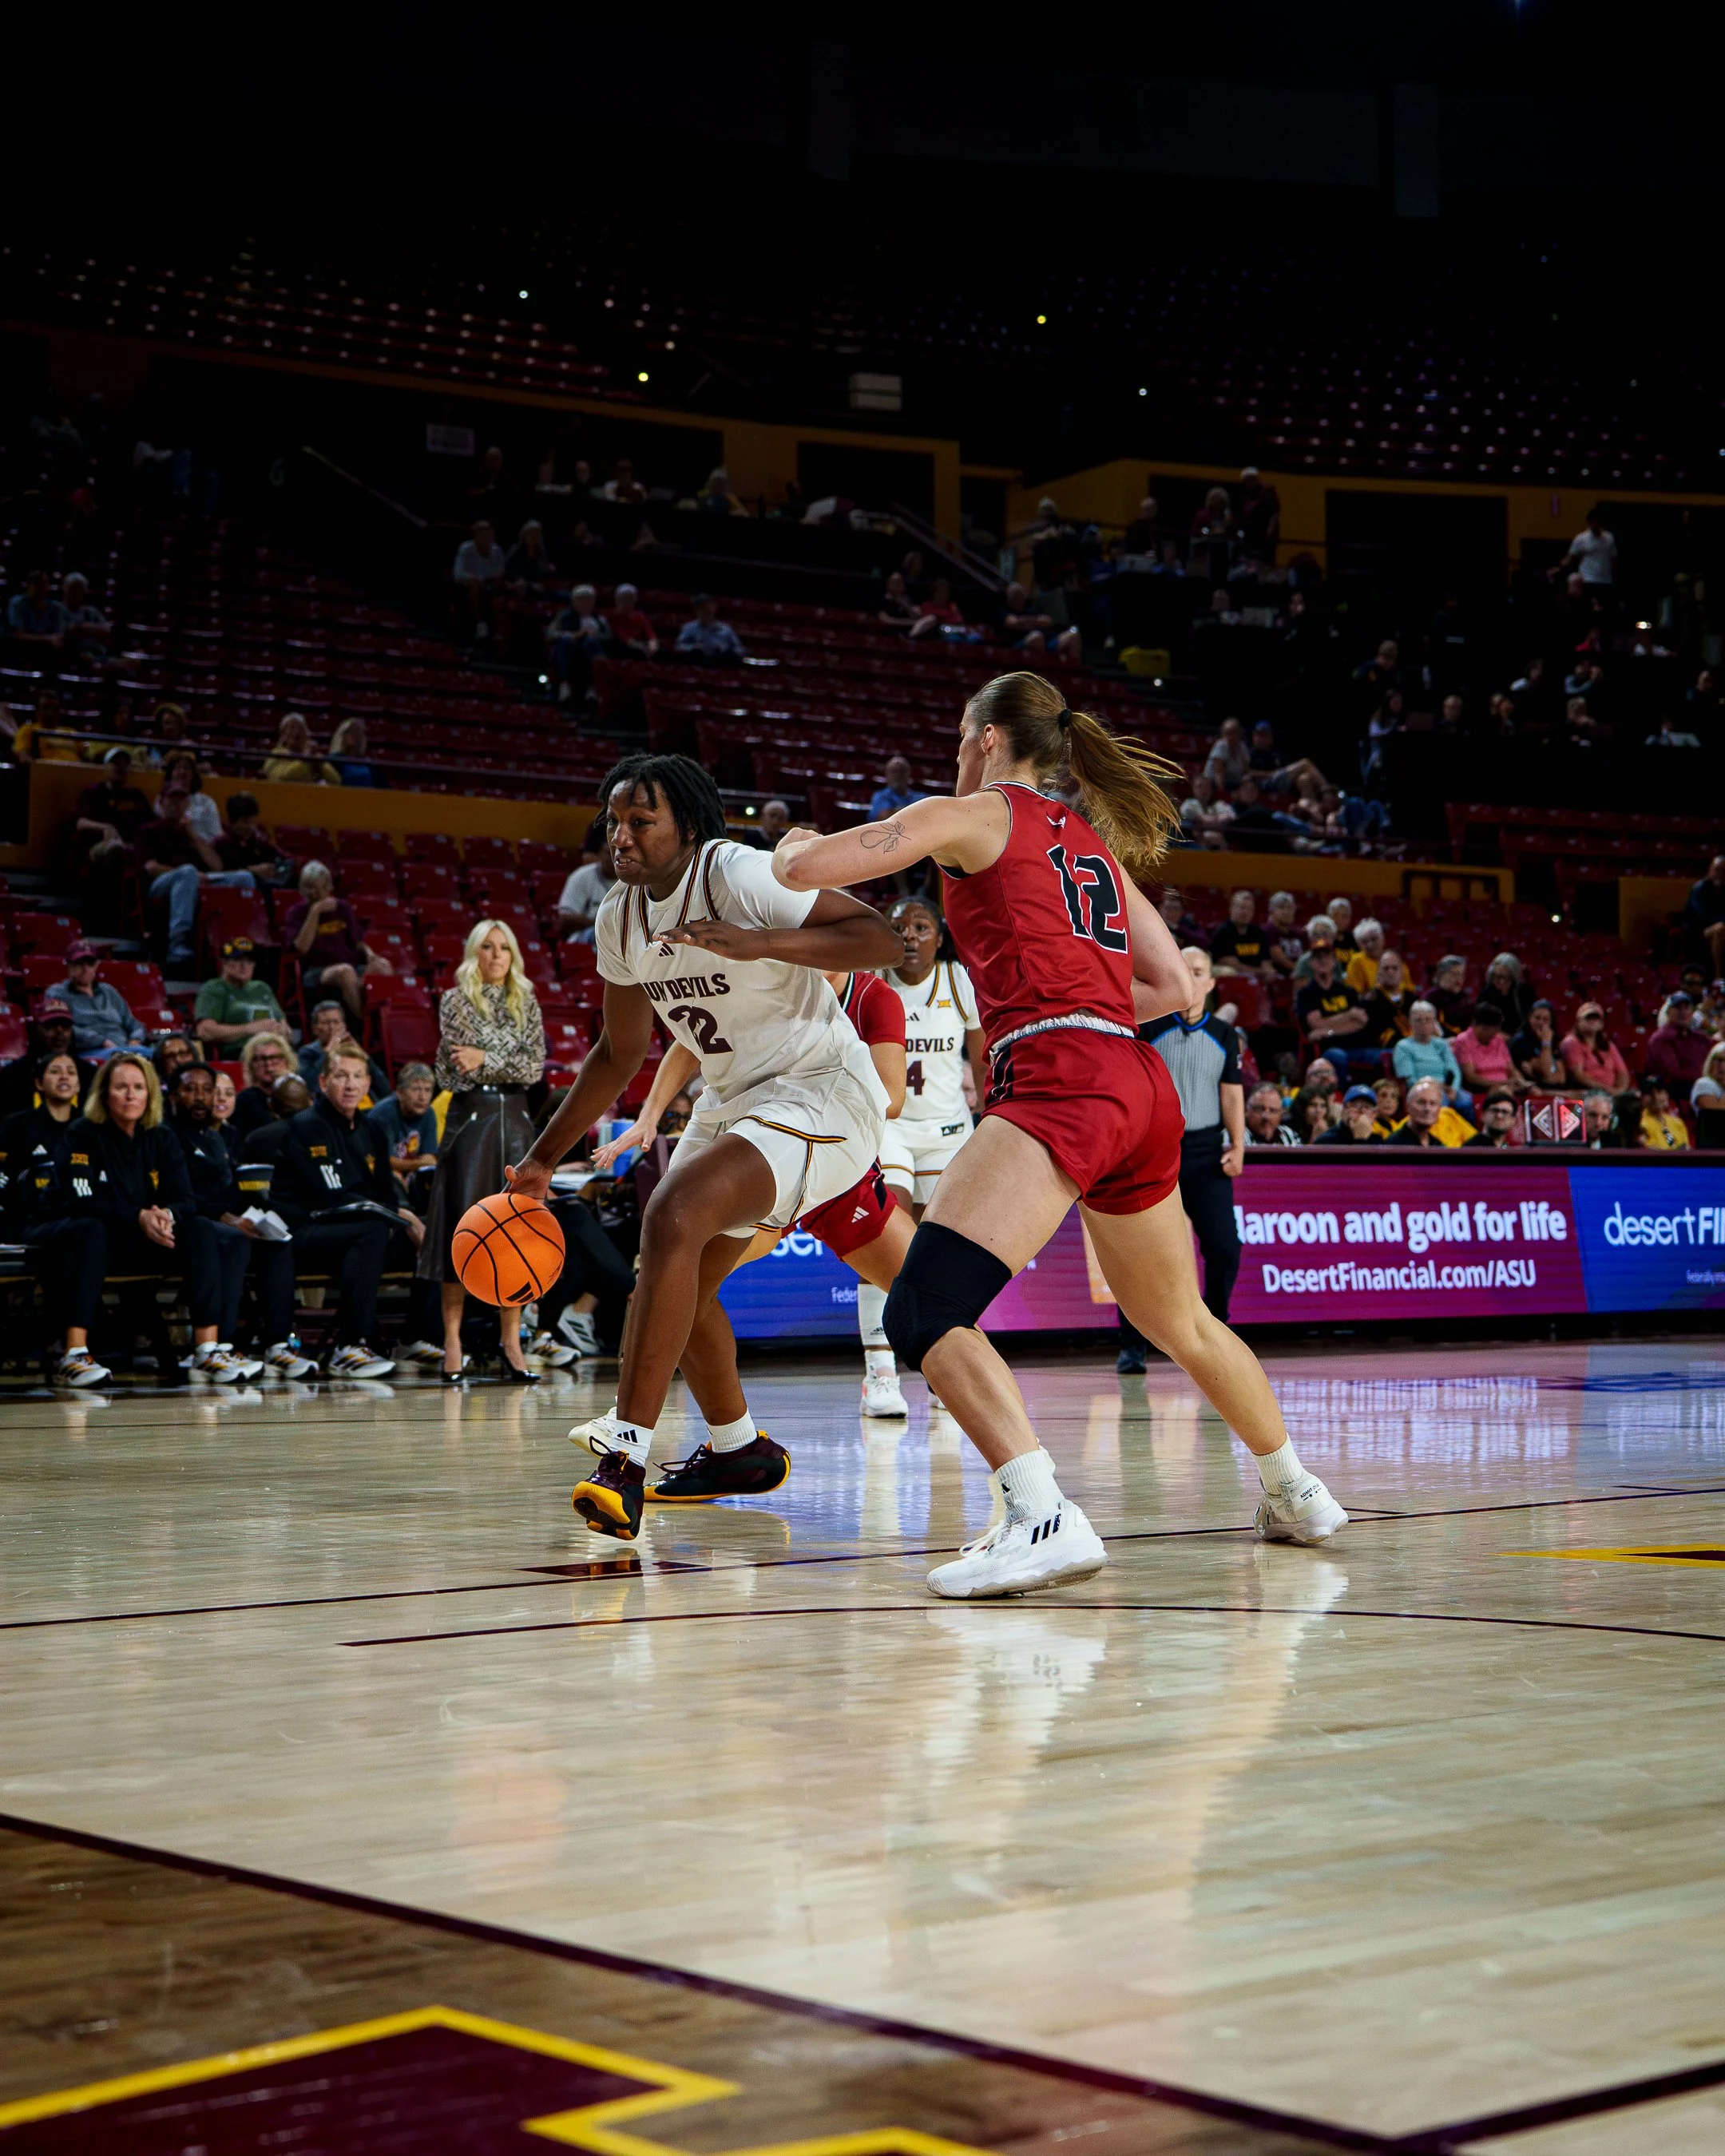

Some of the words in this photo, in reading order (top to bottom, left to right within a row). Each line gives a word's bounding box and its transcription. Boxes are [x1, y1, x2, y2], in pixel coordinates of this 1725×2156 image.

[1046, 843, 1128, 954] 12
[664, 973, 731, 1000] DEVILS
[668, 1005, 734, 1054] 22
[906, 1036, 954, 1052] DEVILS
[906, 1060, 926, 1096] 4
[1344, 1202, 1403, 1243] and
[1406, 1202, 1472, 1254] gold
[1473, 1201, 1517, 1242] for
[1519, 1201, 1568, 1241] life
[1263, 1259, 1537, 1294] DesertFinancial.com/ASU
